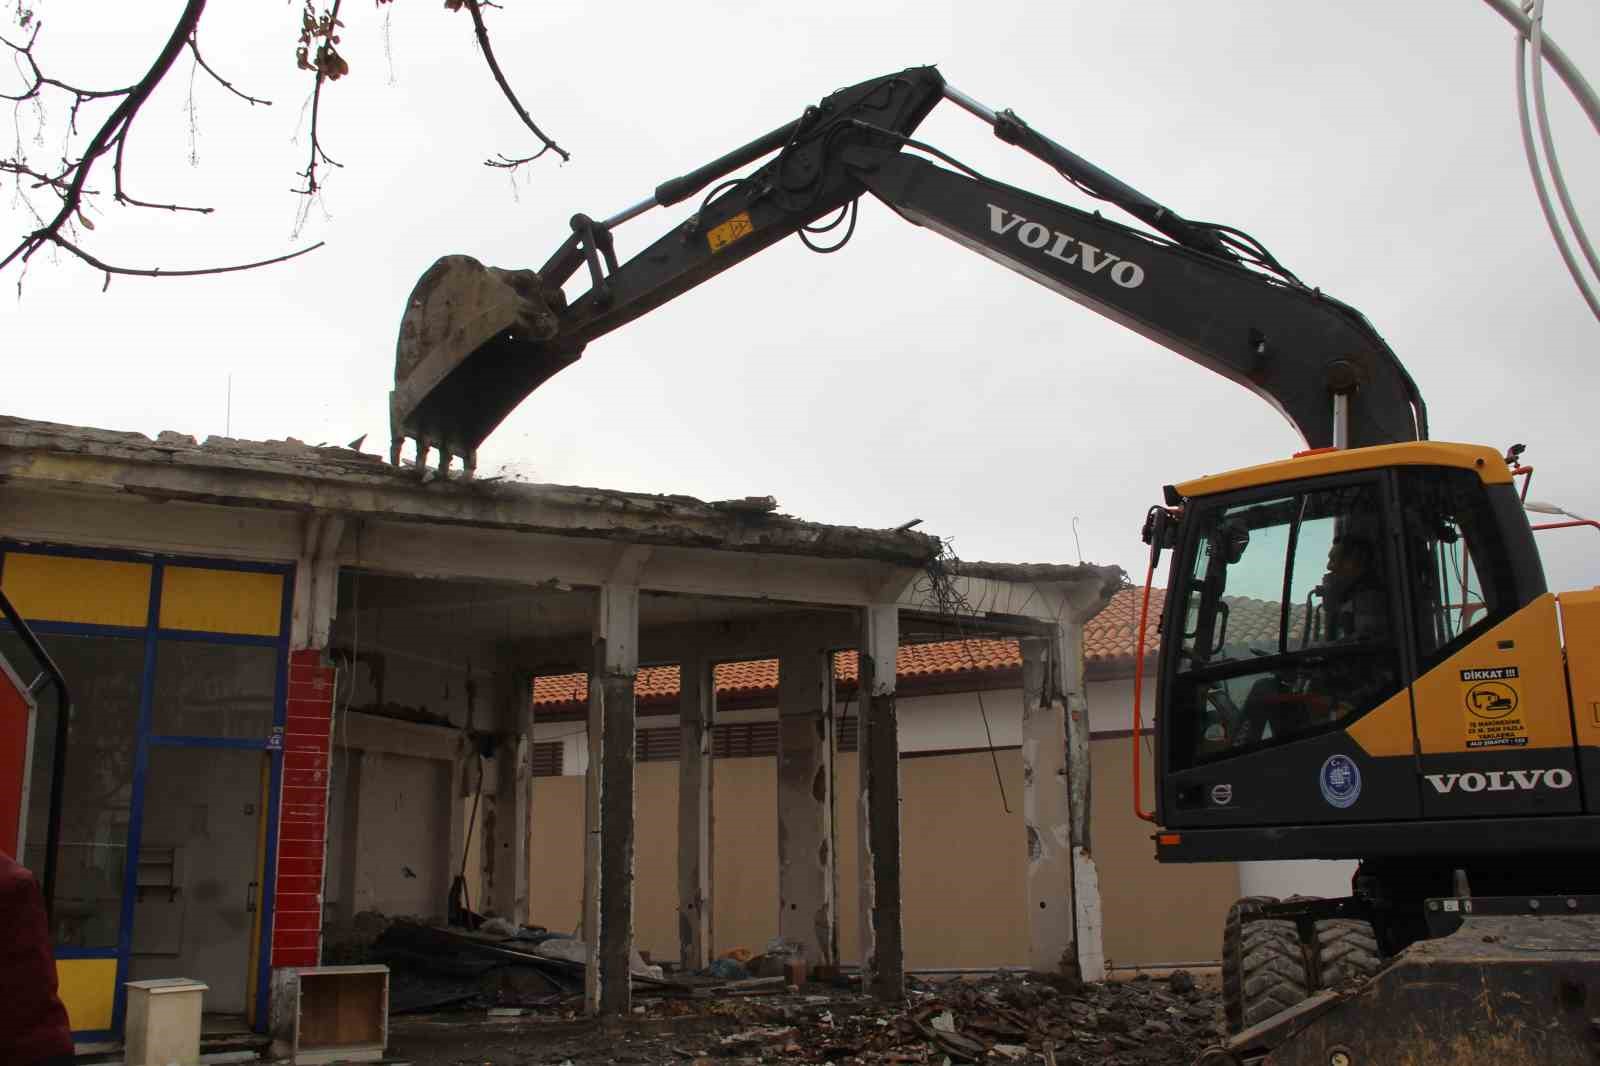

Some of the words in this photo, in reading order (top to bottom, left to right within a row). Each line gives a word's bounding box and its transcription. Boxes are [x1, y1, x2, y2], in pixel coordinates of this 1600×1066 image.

[987, 203, 1144, 289] VOLVO
[1463, 670, 1503, 680] DİKKAT
[1424, 768, 1572, 793] VOLVO
